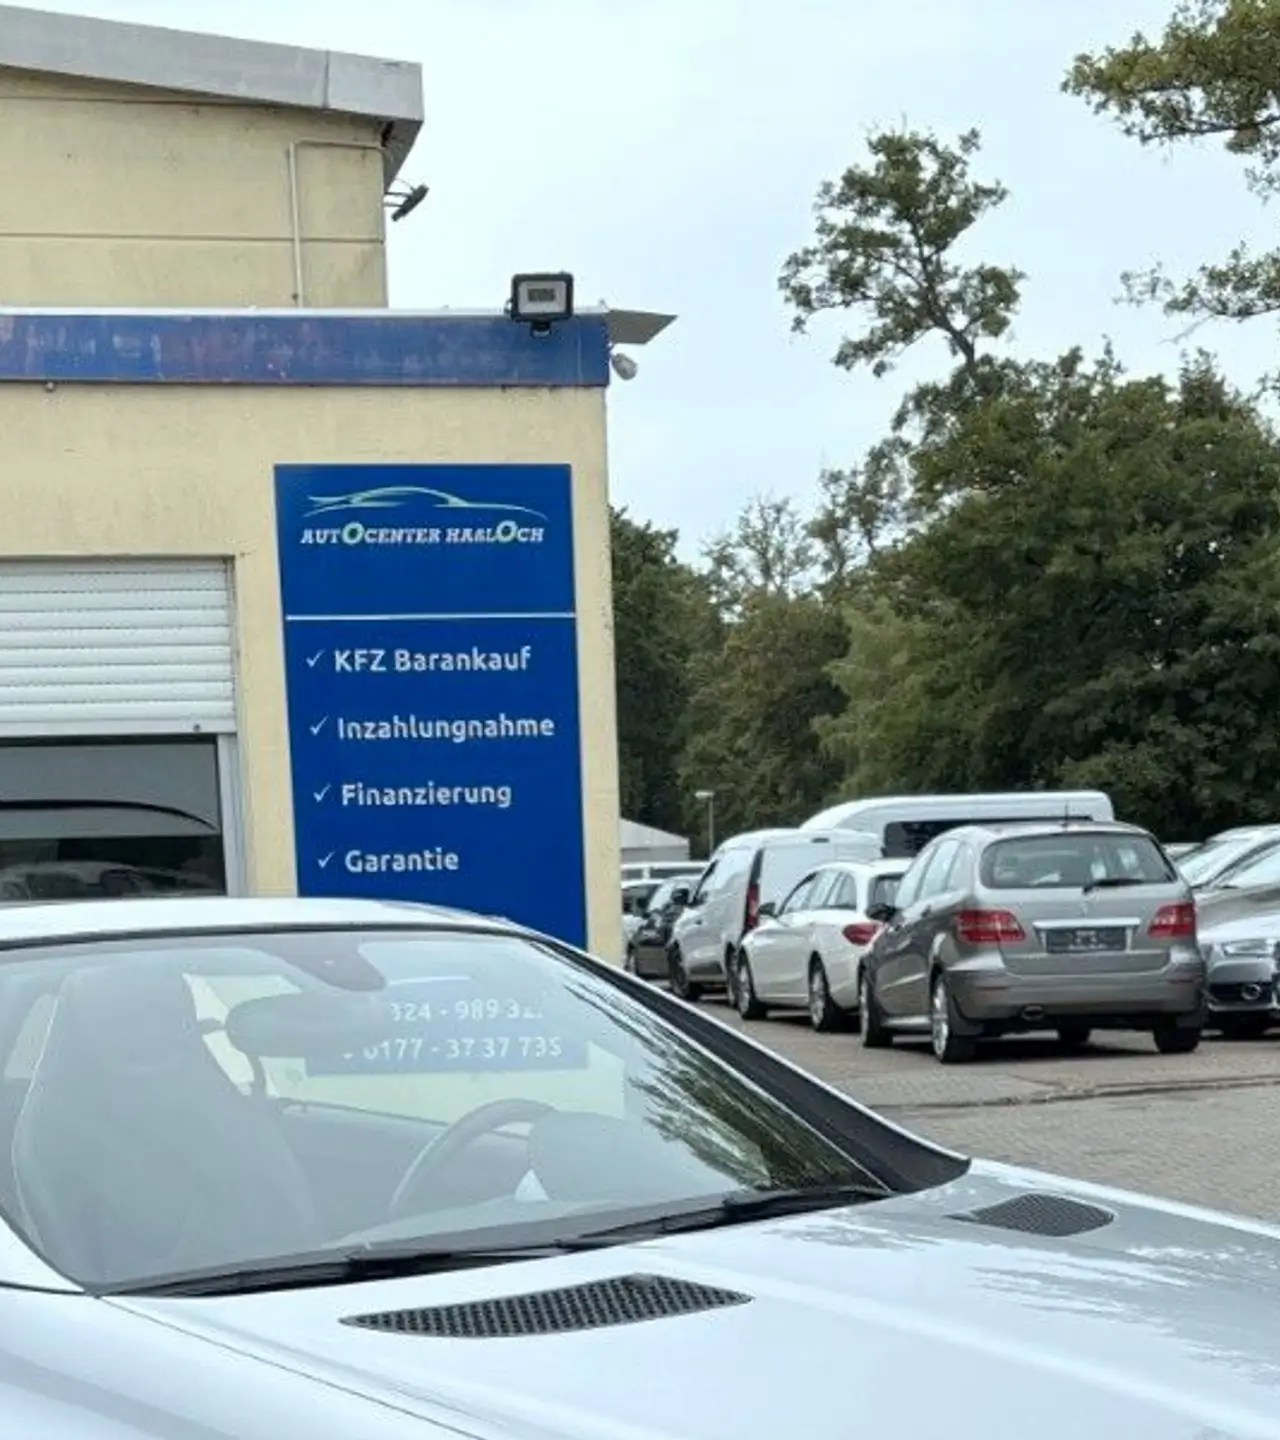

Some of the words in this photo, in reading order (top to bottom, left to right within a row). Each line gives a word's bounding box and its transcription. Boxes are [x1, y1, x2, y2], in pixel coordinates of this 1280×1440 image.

[300, 521, 441, 545] AUTOCENTER
[334, 648, 386, 673] KFZ
[394, 645, 532, 672] Barankauf
[337, 713, 555, 743] Inzahlungnahme
[341, 782, 512, 808] Finanzierung
[345, 847, 459, 873] Garantie
[455, 998, 500, 1020] 989
